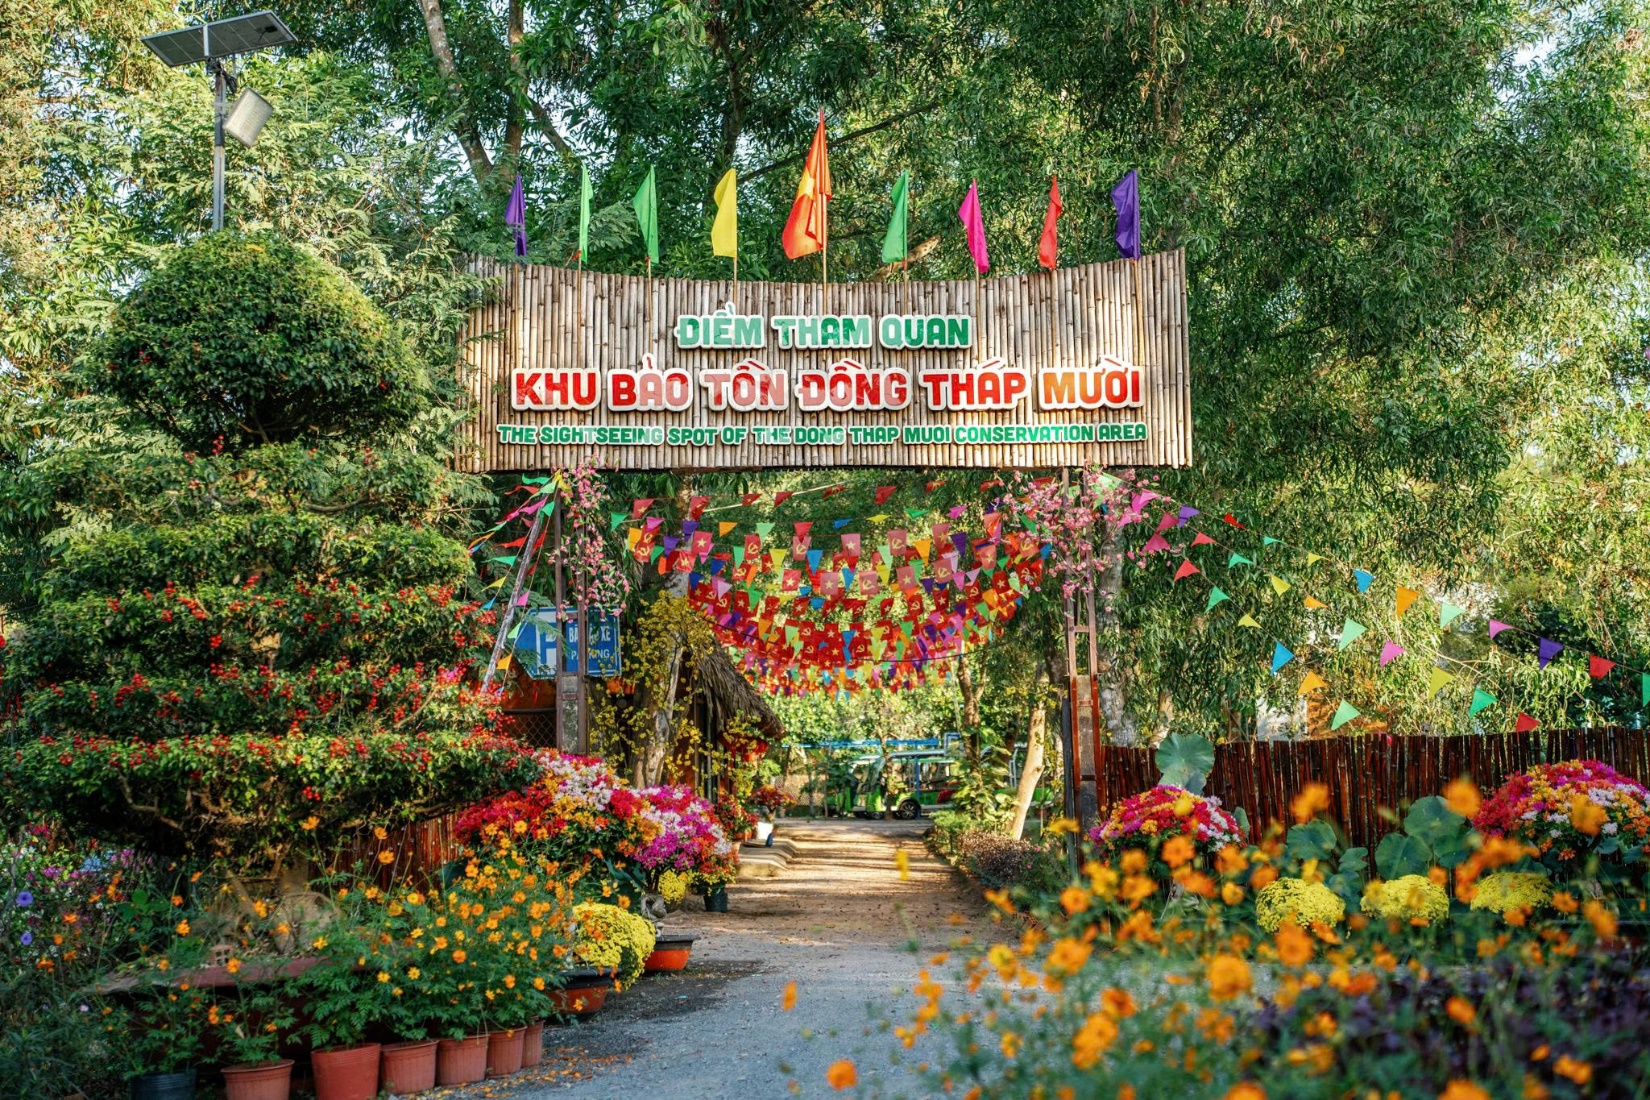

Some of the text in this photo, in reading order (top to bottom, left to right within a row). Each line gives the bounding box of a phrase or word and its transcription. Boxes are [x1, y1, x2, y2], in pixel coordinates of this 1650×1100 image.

[676, 303, 970, 348] ĐIỂM THAM QUAN
[515, 355, 1140, 407] KHU BẢO TỒN ĐỒNG THÁP MƯỜI
[497, 423, 1147, 445] THE SIGHTSEEING SPOT OF THE DONG THAP MUOI CONSERVATION AREA
